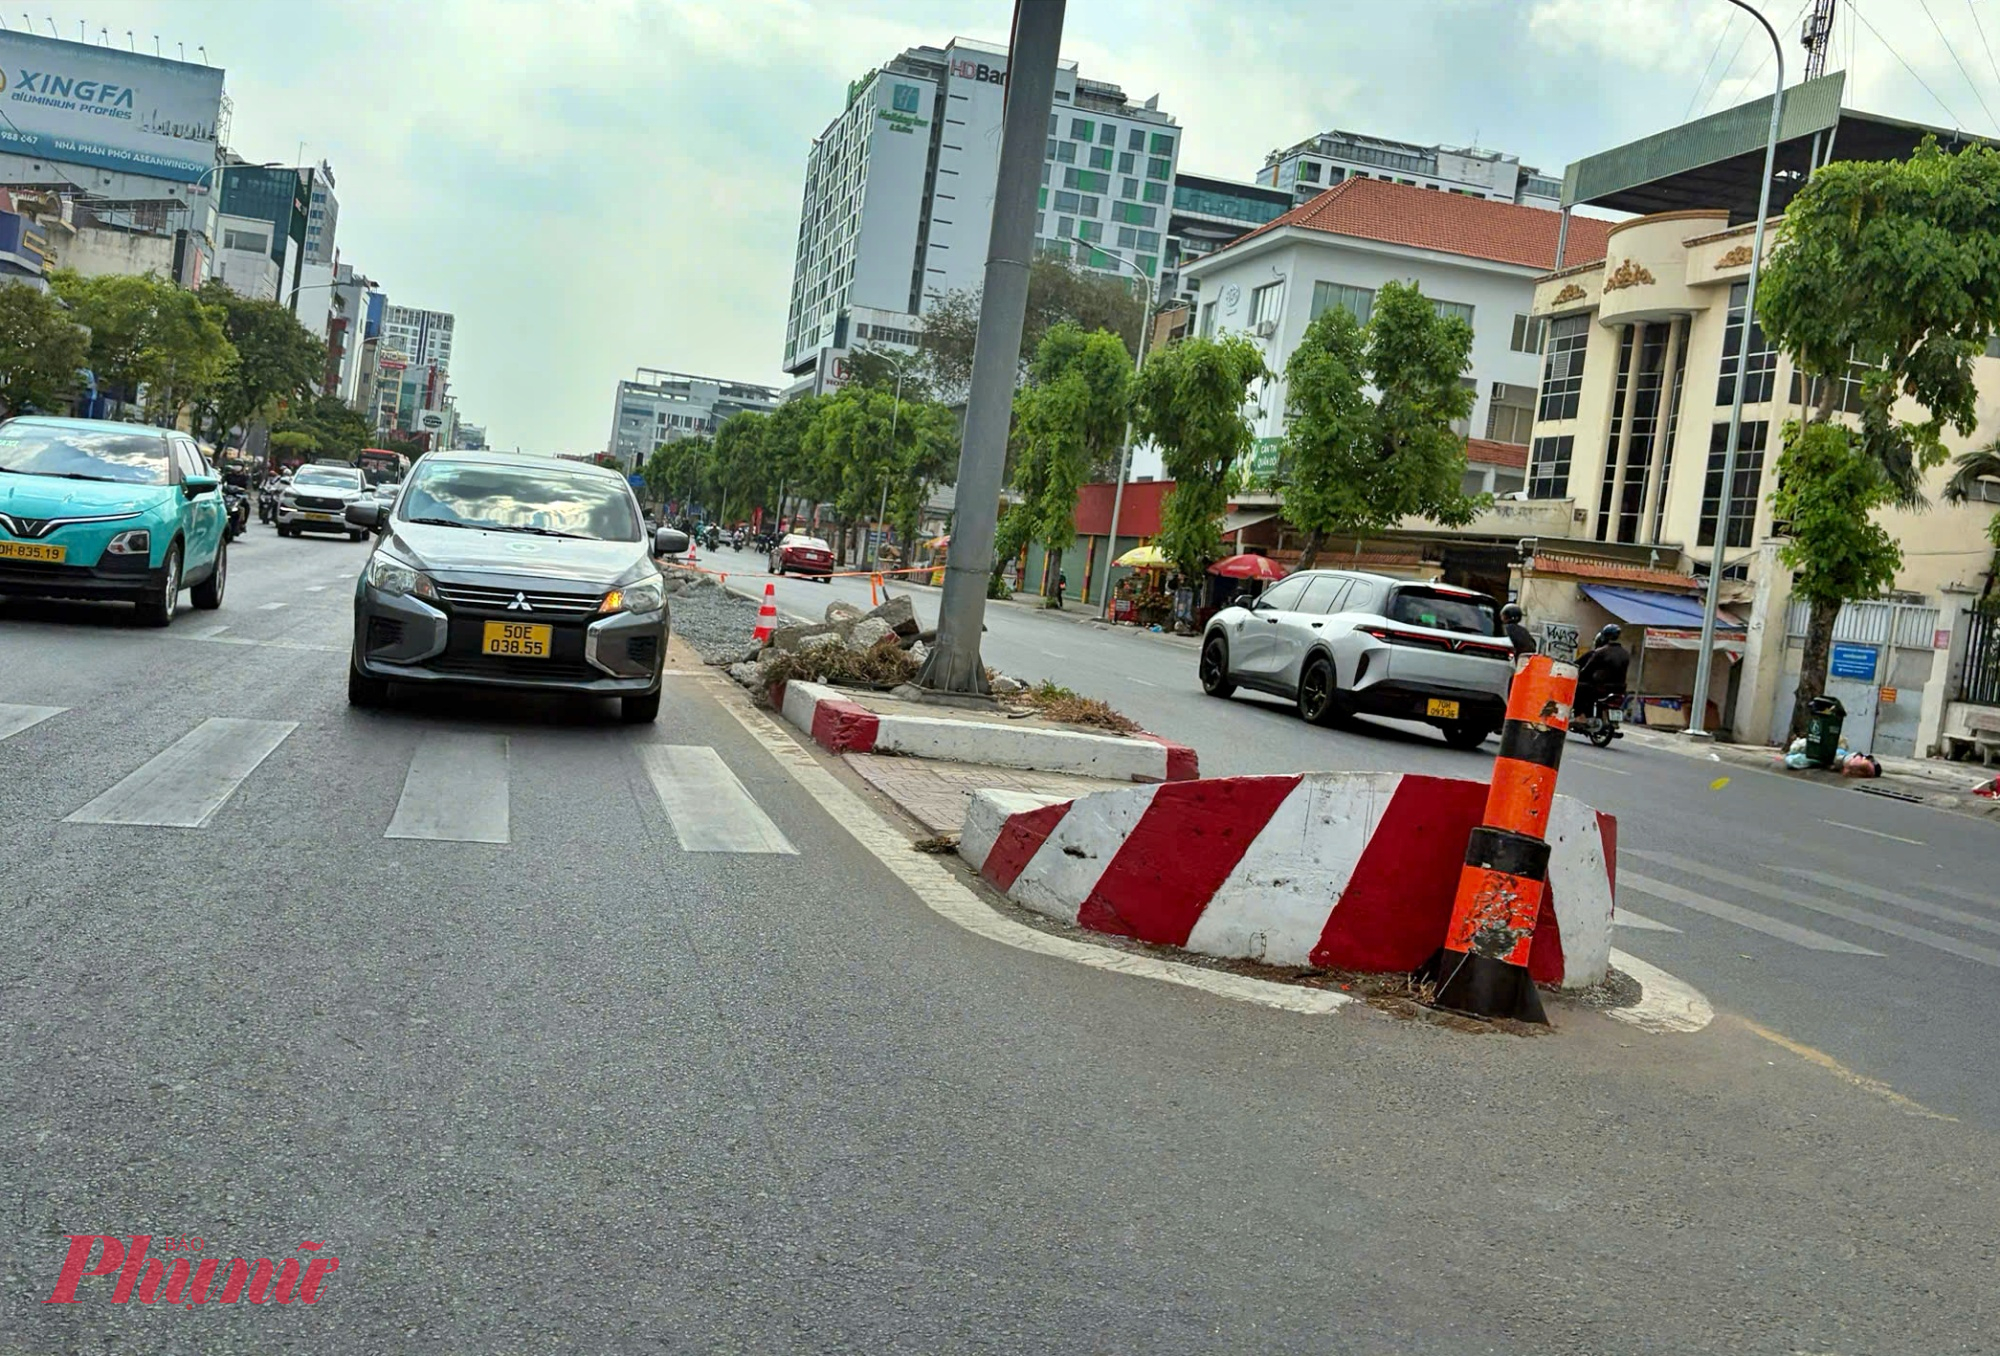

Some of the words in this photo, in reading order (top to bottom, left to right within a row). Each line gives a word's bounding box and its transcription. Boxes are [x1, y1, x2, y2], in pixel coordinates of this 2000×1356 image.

[14, 69, 133, 109] XINGFA
[133, 153, 204, 173] ASEANWINDOW
[504, 625, 533, 640] 50E
[490, 639, 543, 655] 038.55
